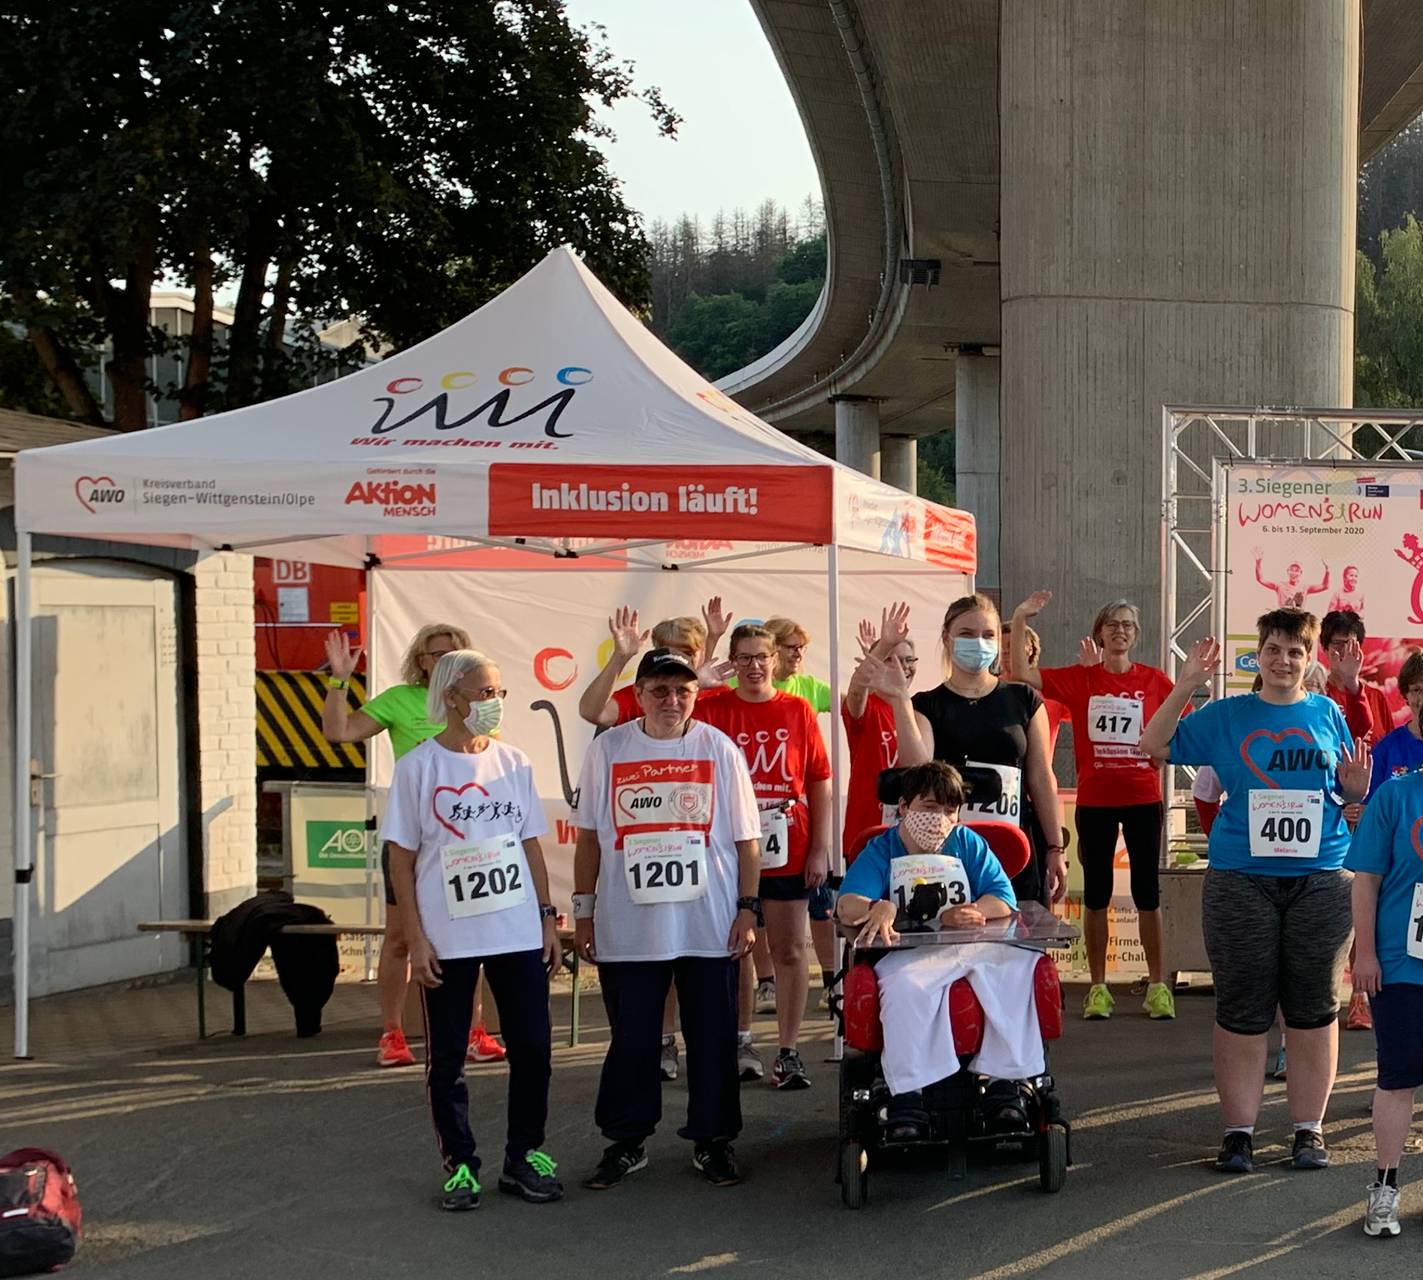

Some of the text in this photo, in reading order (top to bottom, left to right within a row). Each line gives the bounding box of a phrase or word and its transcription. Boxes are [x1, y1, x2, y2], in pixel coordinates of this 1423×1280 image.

[350, 437, 559, 450] Wir machen mit.
[142, 479, 216, 489] Kreisverband
[1238, 478, 1331, 498] 3. Siegener
[89, 489, 125, 503] AWO
[143, 491, 316, 507] Siegen-Wittgenstein/Olpe
[532, 482, 758, 515] Inklusion läuft!
[383, 506, 436, 517] MENSCH
[1300, 526, 1342, 535] September
[276, 560, 307, 580] DB
[1096, 715, 1132, 734] 417
[1266, 749, 1331, 771] AWO
[617, 764, 699, 784] zwei Partner
[630, 797, 662, 809] AWO
[1260, 817, 1311, 842] 400
[448, 863, 522, 902] 1202
[629, 860, 699, 889] 1201
